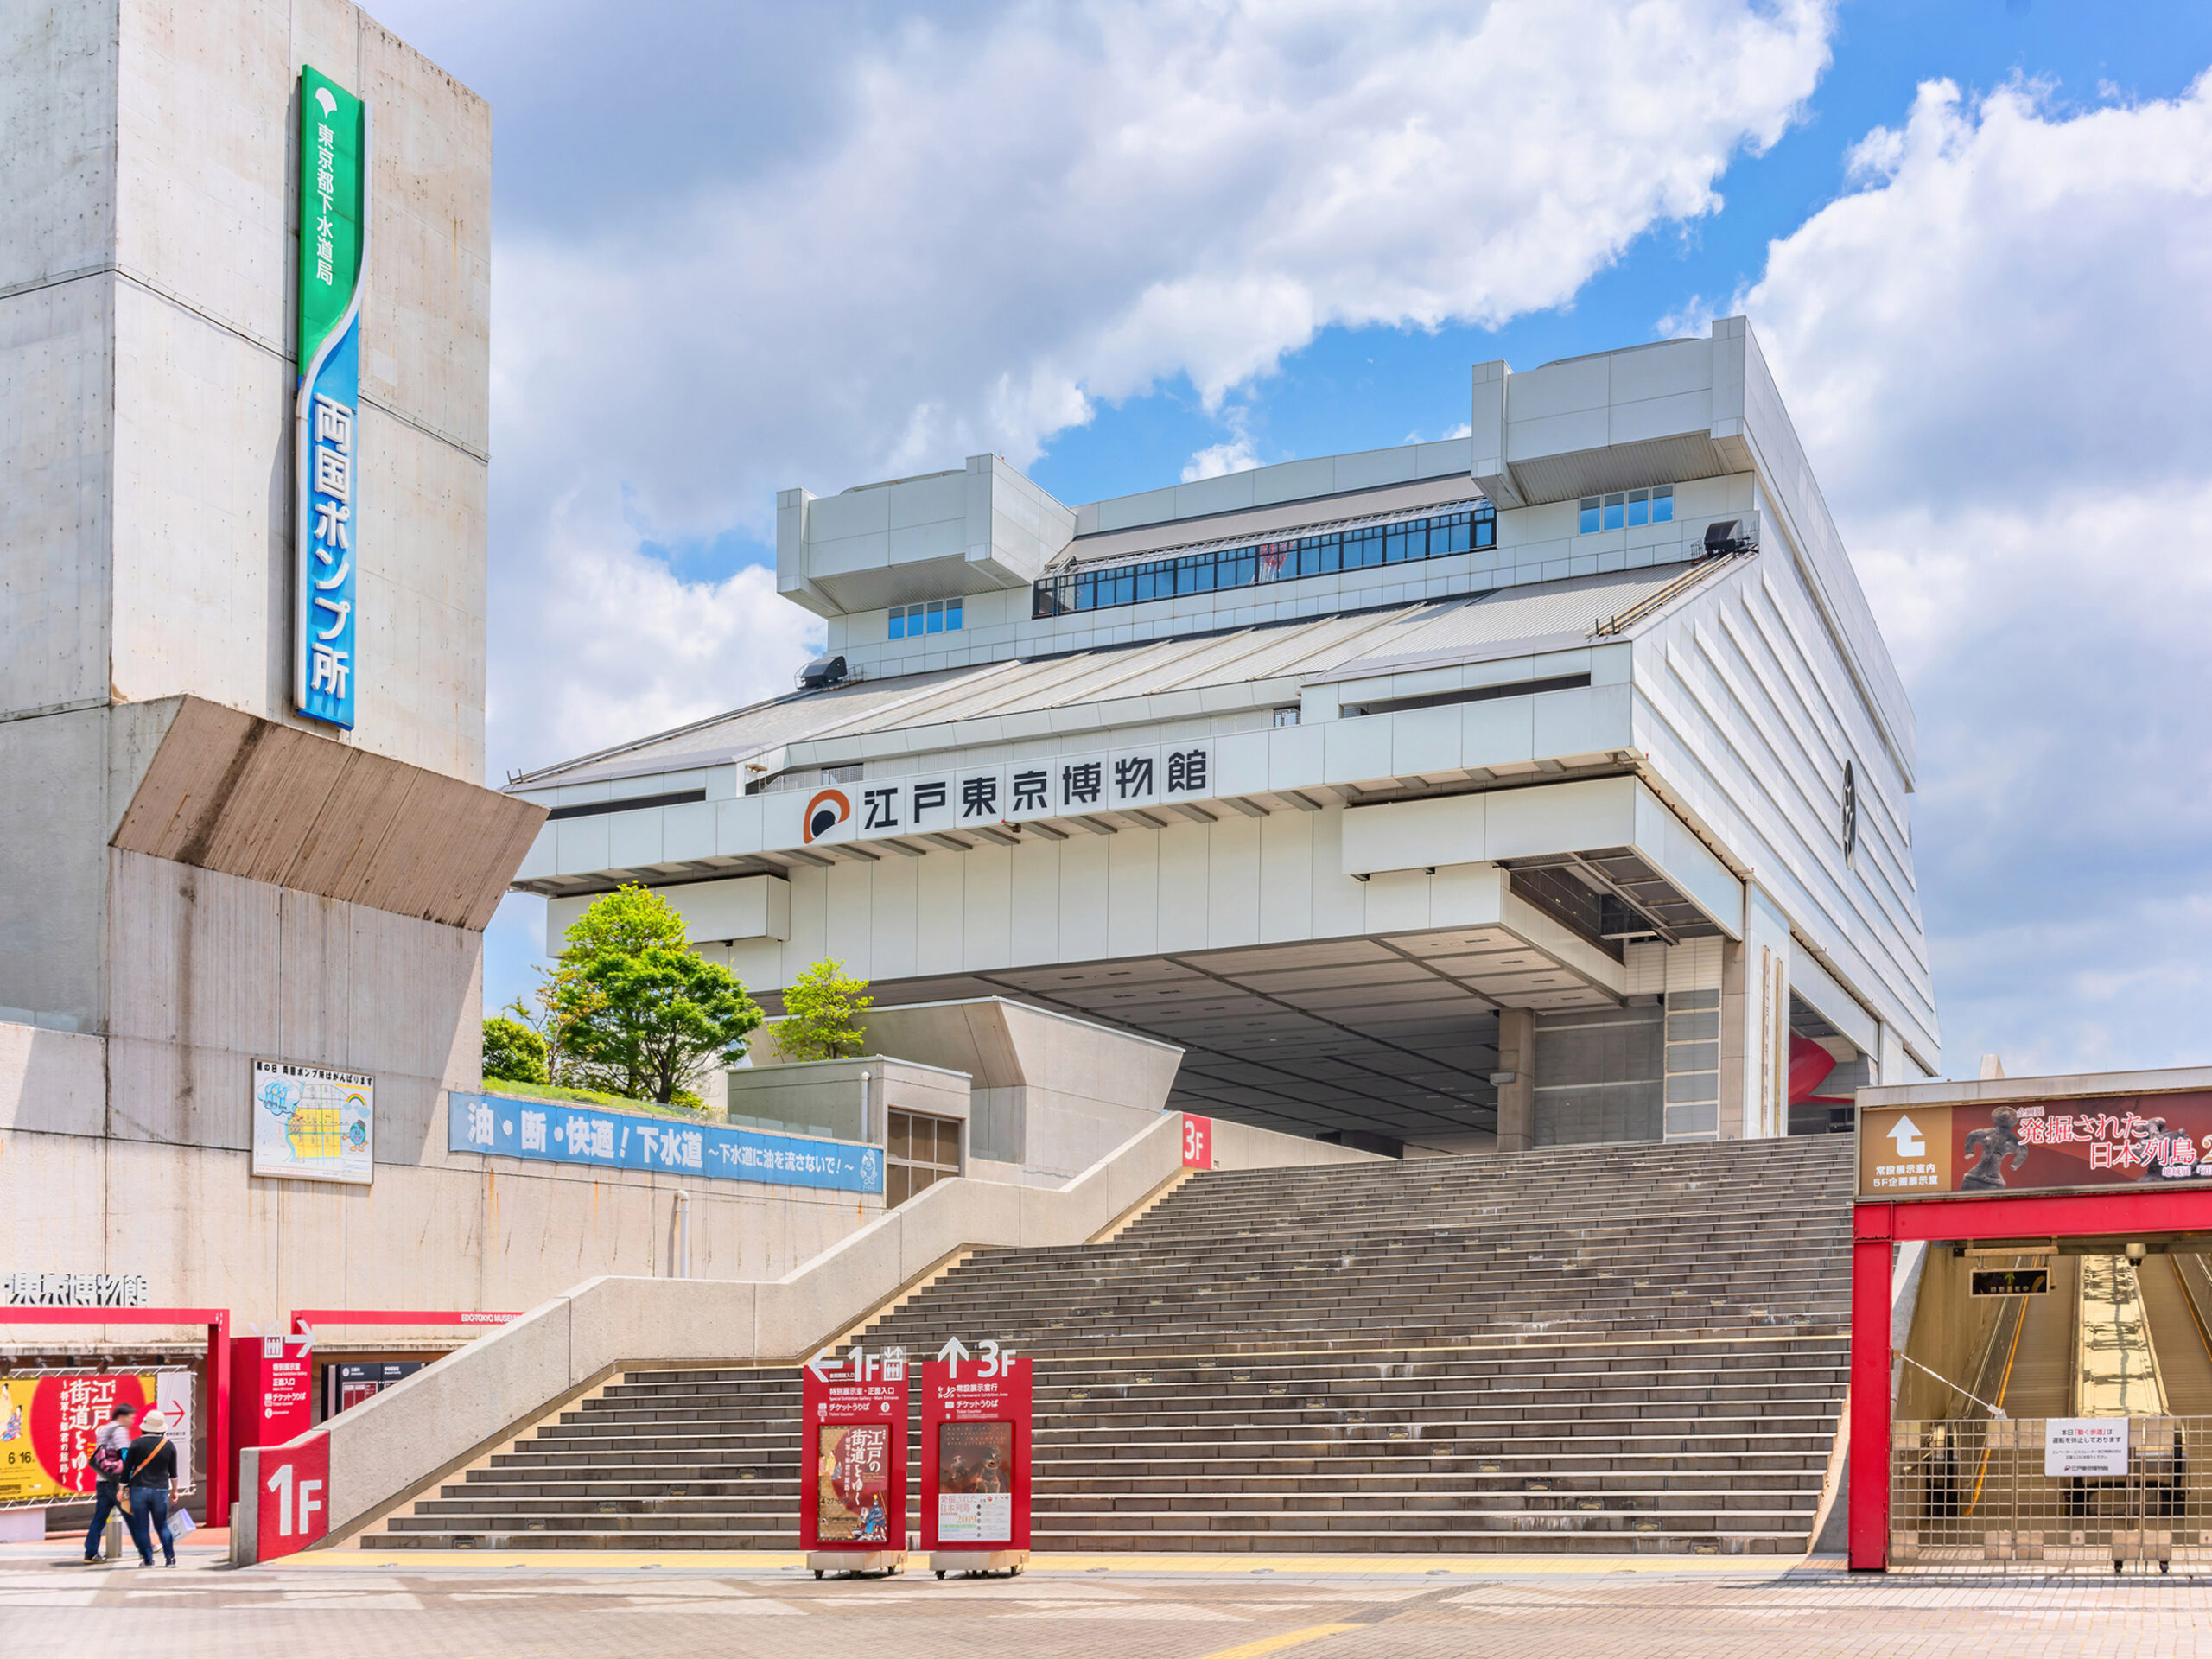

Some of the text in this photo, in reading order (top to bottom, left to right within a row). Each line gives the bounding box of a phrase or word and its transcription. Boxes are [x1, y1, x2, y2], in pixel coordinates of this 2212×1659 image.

[316, 123, 334, 286] 東京都下水道局
[312, 392, 353, 698] 両国ポンプ所
[864, 749, 1206, 830] 江戸東京博物館
[1185, 1121, 1203, 1160] 3F
[2018, 1111, 2149, 1146] 発掘された
[2090, 1137, 2197, 1170] 日本列島
[848, 1346, 880, 1382] 1F
[977, 1340, 1016, 1377] 3F
[267, 1464, 322, 1536] 1F
